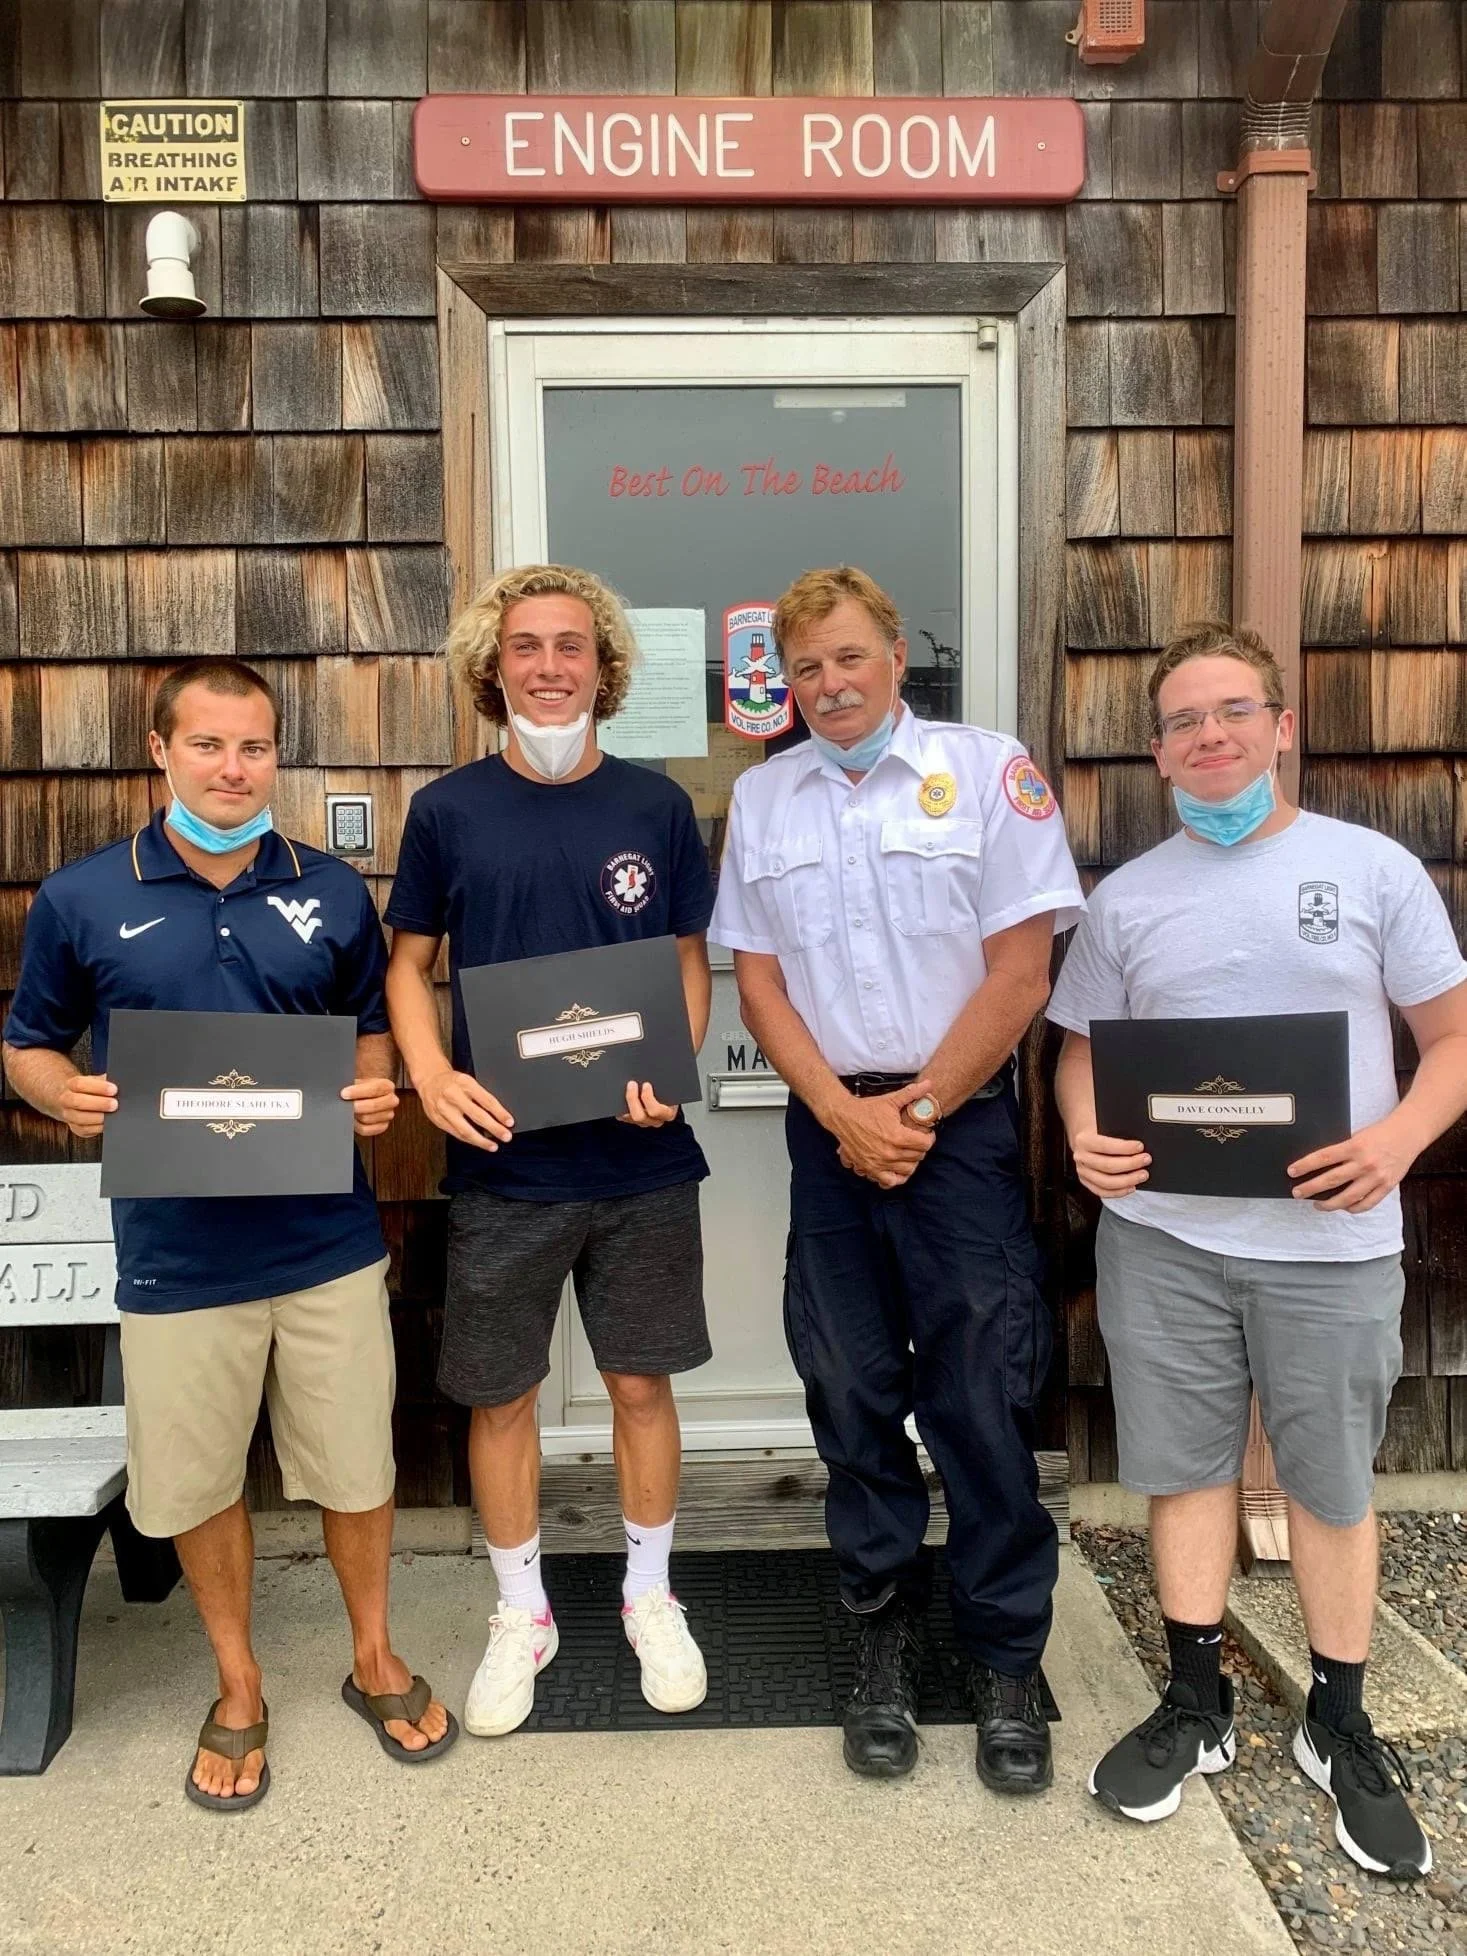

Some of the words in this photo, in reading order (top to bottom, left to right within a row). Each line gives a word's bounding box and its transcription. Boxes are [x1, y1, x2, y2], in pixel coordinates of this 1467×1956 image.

[111, 113, 233, 135] CAUTION
[504, 112, 755, 177] ENGINE
[803, 113, 996, 179] ROOM
[108, 152, 238, 168] BREATHING
[109, 176, 149, 192] AR
[608, 464, 675, 497] Best
[681, 464, 730, 497] On
[741, 456, 804, 496] The
[811, 452, 906, 496] Beach
[729, 611, 766, 629] BARNEGAT
[746, 721, 761, 734] FIRE
[606, 853, 641, 872] BARNEGAT
[620, 905, 633, 914] AID
[576, 1027, 616, 1040] SHIELDS
[727, 1045, 768, 1072] MA
[176, 1099, 231, 1109] THEODORE
[1177, 1105, 1206, 1114] DAVE
[1207, 1106, 1266, 1115] CONNELLY
